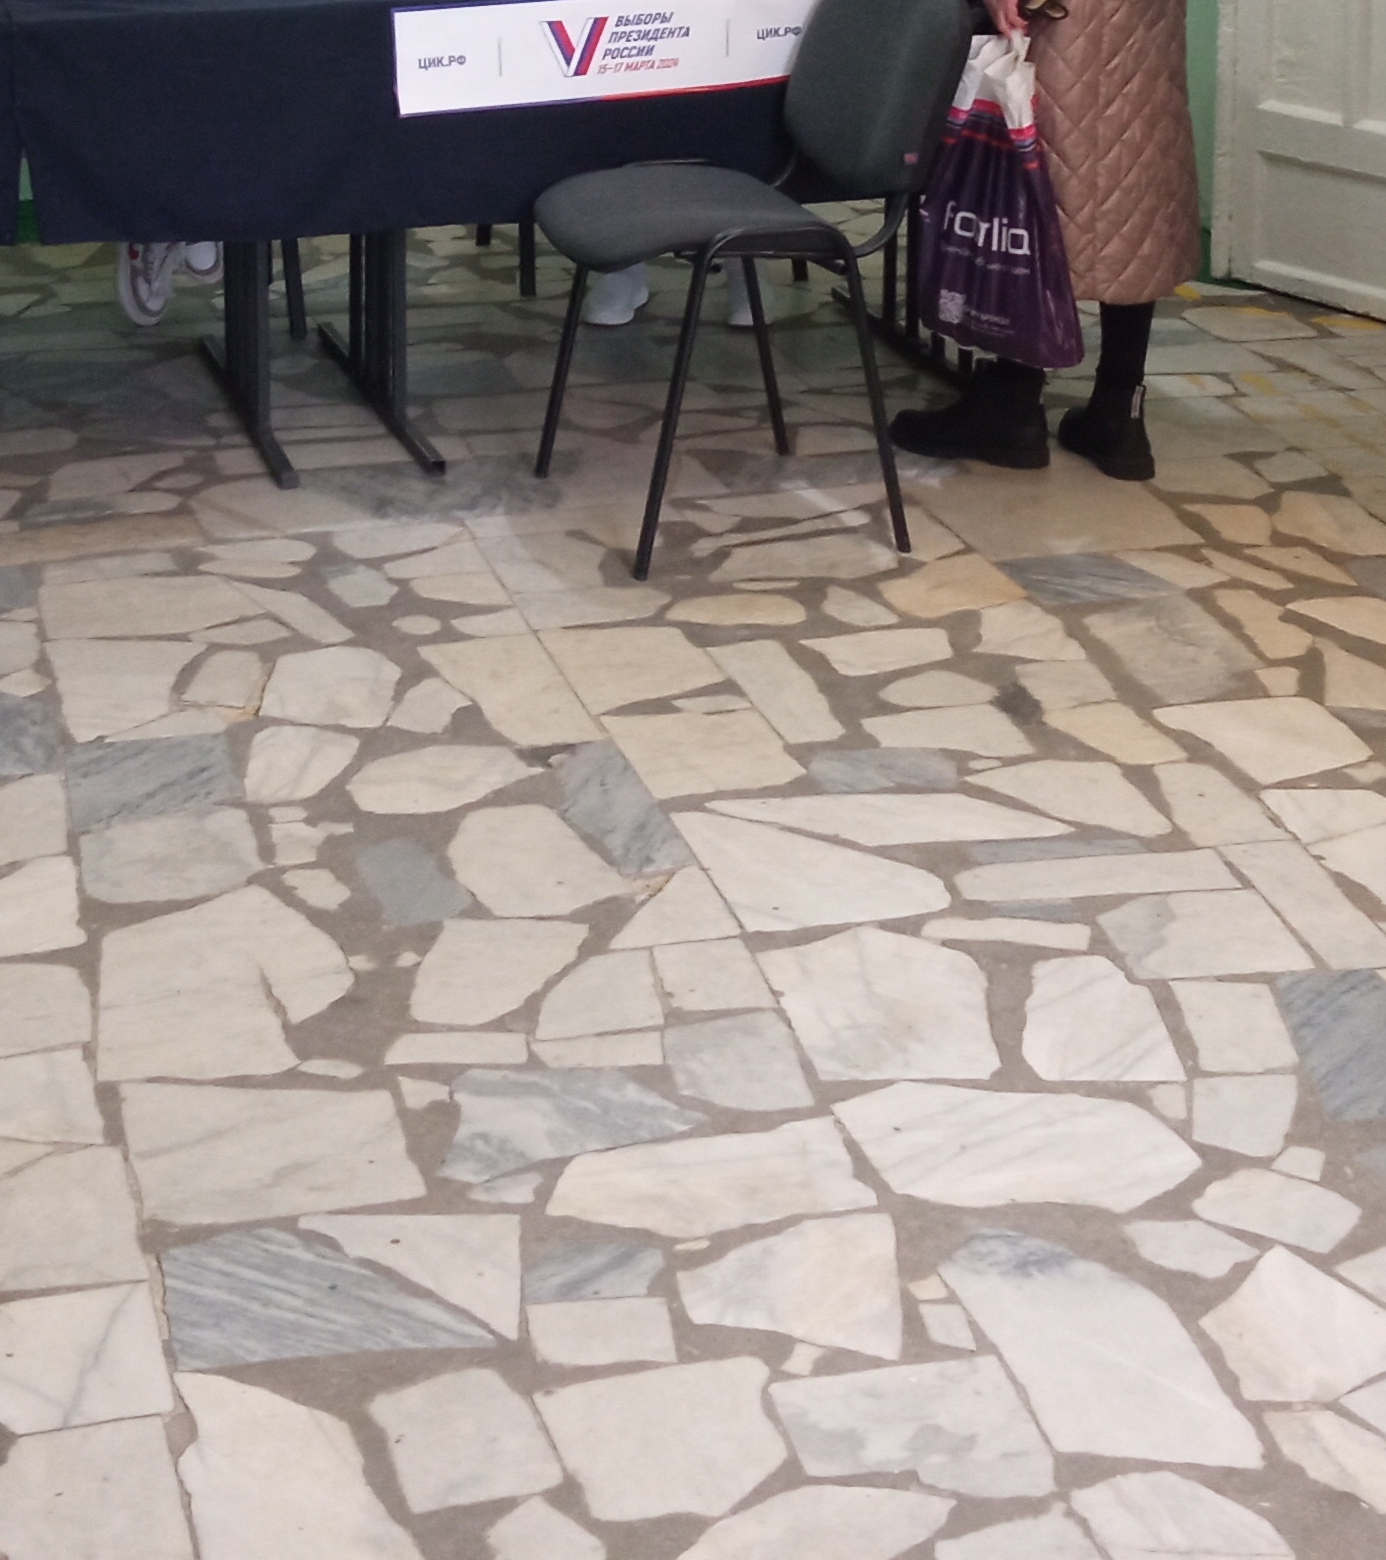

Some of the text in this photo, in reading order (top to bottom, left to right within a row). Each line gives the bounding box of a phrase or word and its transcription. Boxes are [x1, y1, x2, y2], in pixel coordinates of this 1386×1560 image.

[614, 11, 674, 28] ВЫБОРЫ
[608, 25, 691, 44] ПРЕЗИДЕНТА
[602, 44, 655, 61] РОССИИ
[417, 54, 467, 71] ЦИК.РФ
[625, 59, 656, 73] МАРТА
